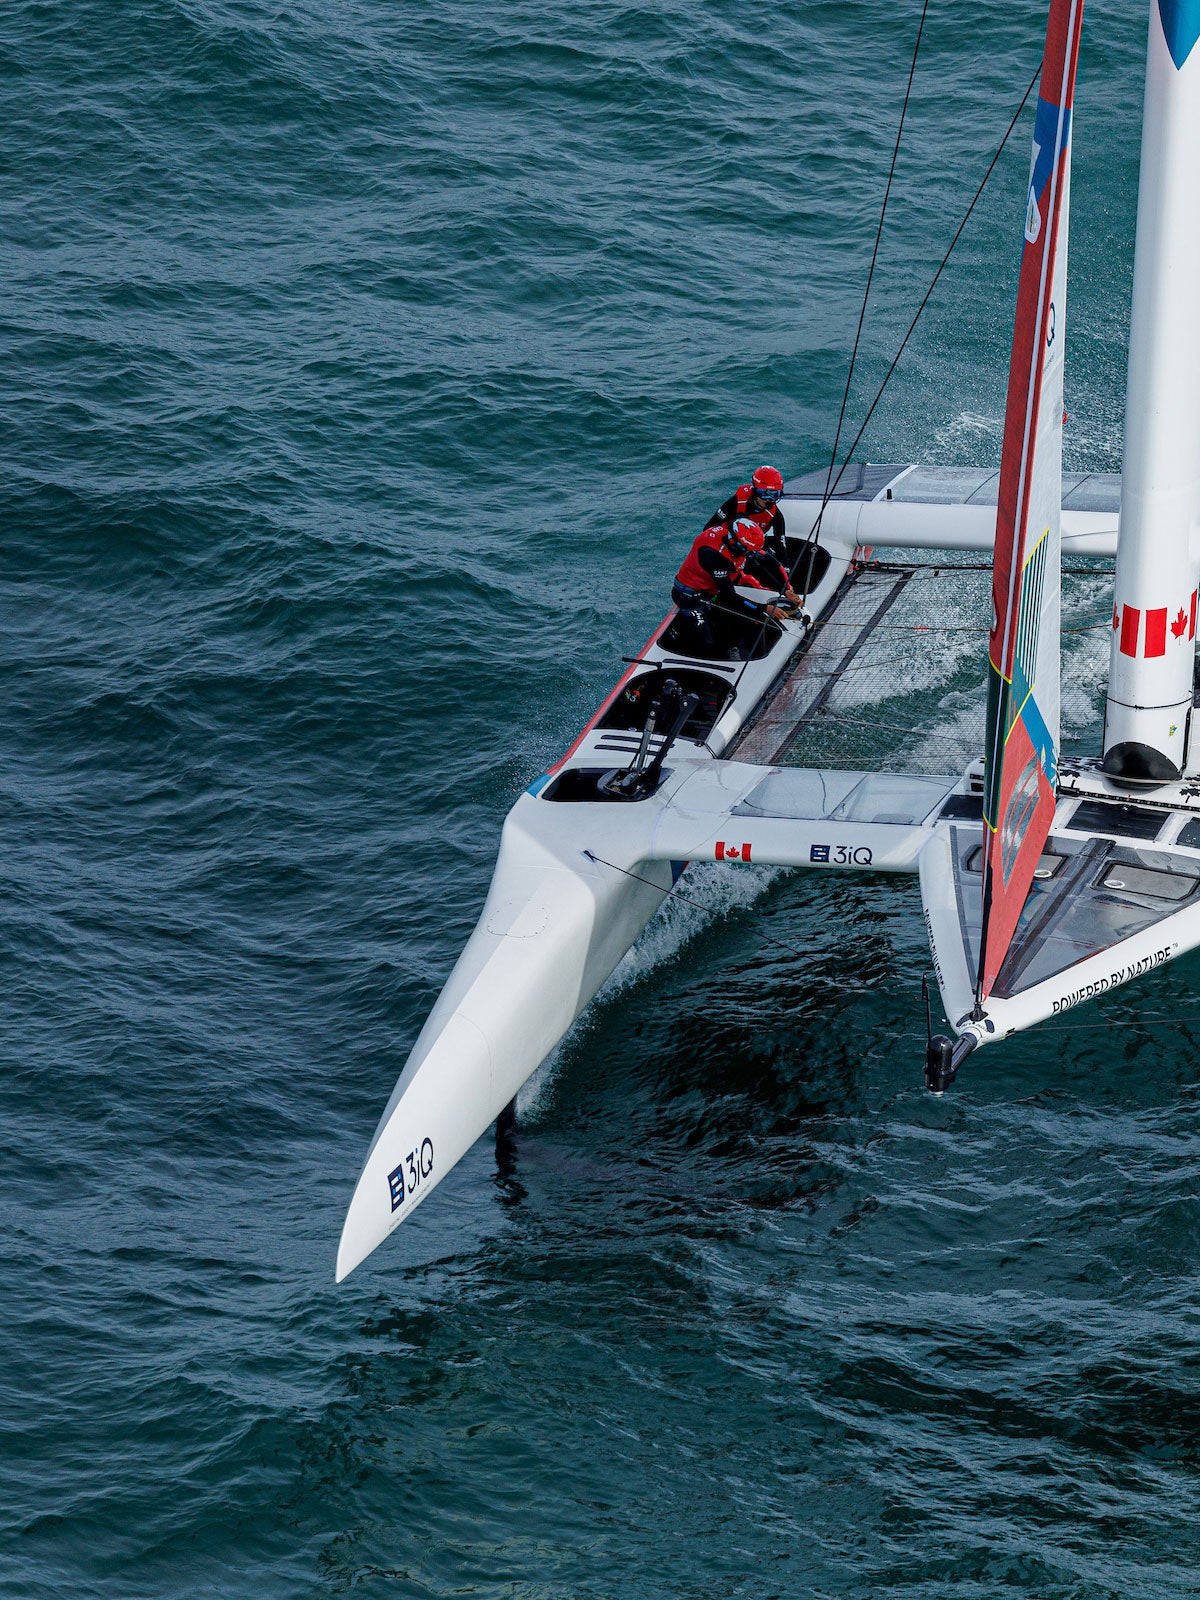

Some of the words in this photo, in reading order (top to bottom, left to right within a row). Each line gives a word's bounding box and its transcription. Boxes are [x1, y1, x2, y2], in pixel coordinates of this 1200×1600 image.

[833, 845, 873, 866] 3iQ
[1051, 978, 1110, 1017] POWERED
[1109, 969, 1126, 990] BY
[1125, 946, 1172, 981] NATURE
[405, 1136, 434, 1195] 3iQ
